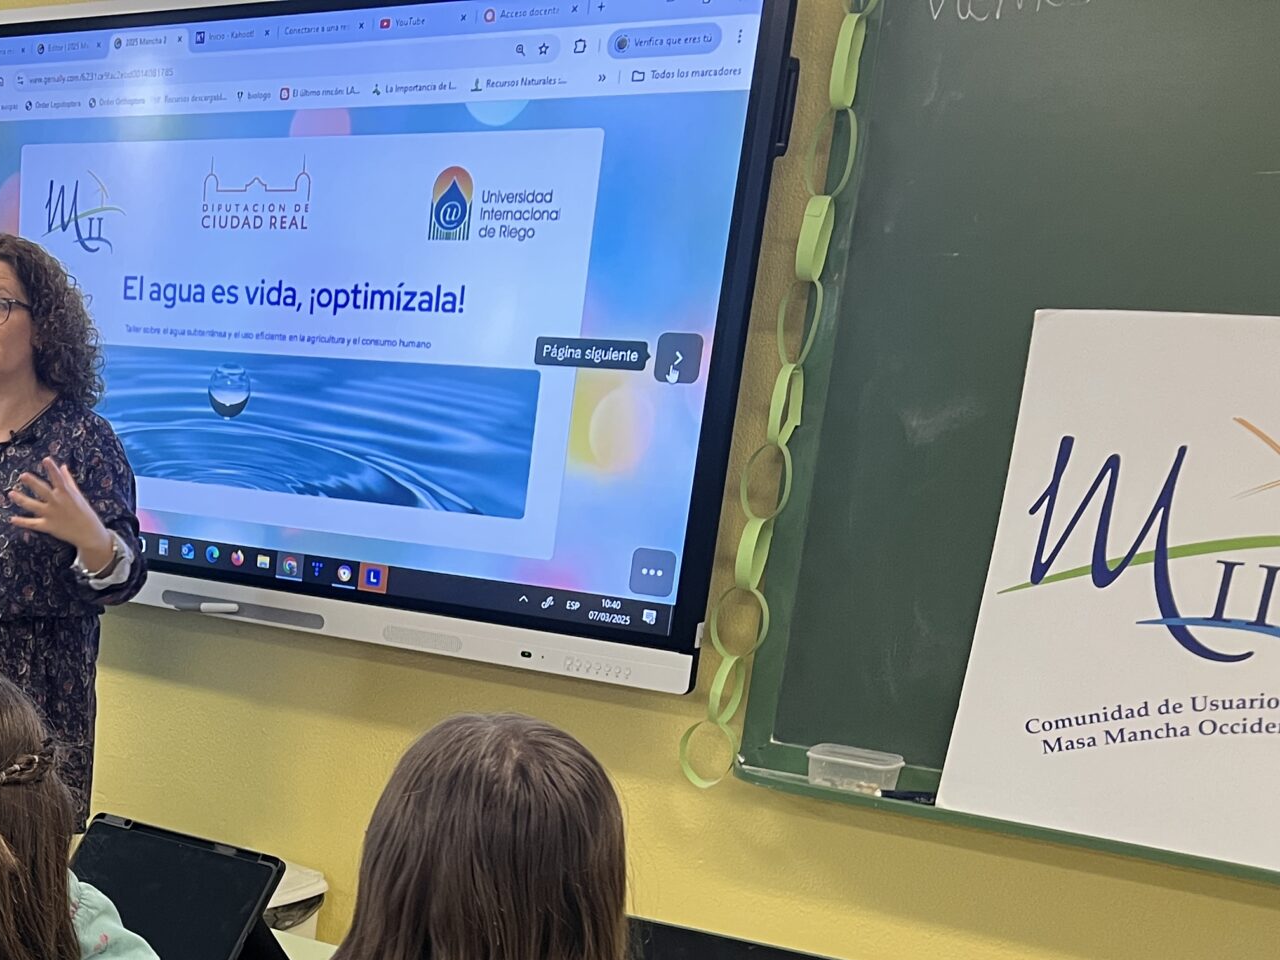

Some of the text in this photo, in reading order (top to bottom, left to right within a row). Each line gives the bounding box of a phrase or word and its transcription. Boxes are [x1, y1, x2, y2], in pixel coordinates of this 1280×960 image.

[396, 17, 425, 27] YouTube
[666, 38, 682, 48] que
[684, 36, 701, 44] eres
[703, 34, 712, 43] tú
[651, 67, 742, 79] Todos los marcadores
[486, 78, 519, 88] Recursos
[521, 76, 556, 87] Naturales
[482, 190, 553, 204] Universidad
[294, 204, 310, 213] DE
[480, 208, 561, 220] Internacional
[201, 215, 308, 230] CIUDAD REAL
[478, 225, 535, 241] de Riego
[123, 276, 465, 316] El agua es vida, ¡optimízala!
[307, 334, 345, 345] agricultura
[353, 337, 360, 345] el
[399, 339, 431, 349] humano
[542, 344, 639, 363] Página siguiente
[566, 598, 621, 611] ESP 10:40
[588, 610, 631, 625] 07/03/2025
[1025, 701, 1150, 734] Comunidad
[1157, 699, 1183, 716] de
[1042, 733, 1097, 755] Masa
[1104, 722, 1190, 745] Mancha
